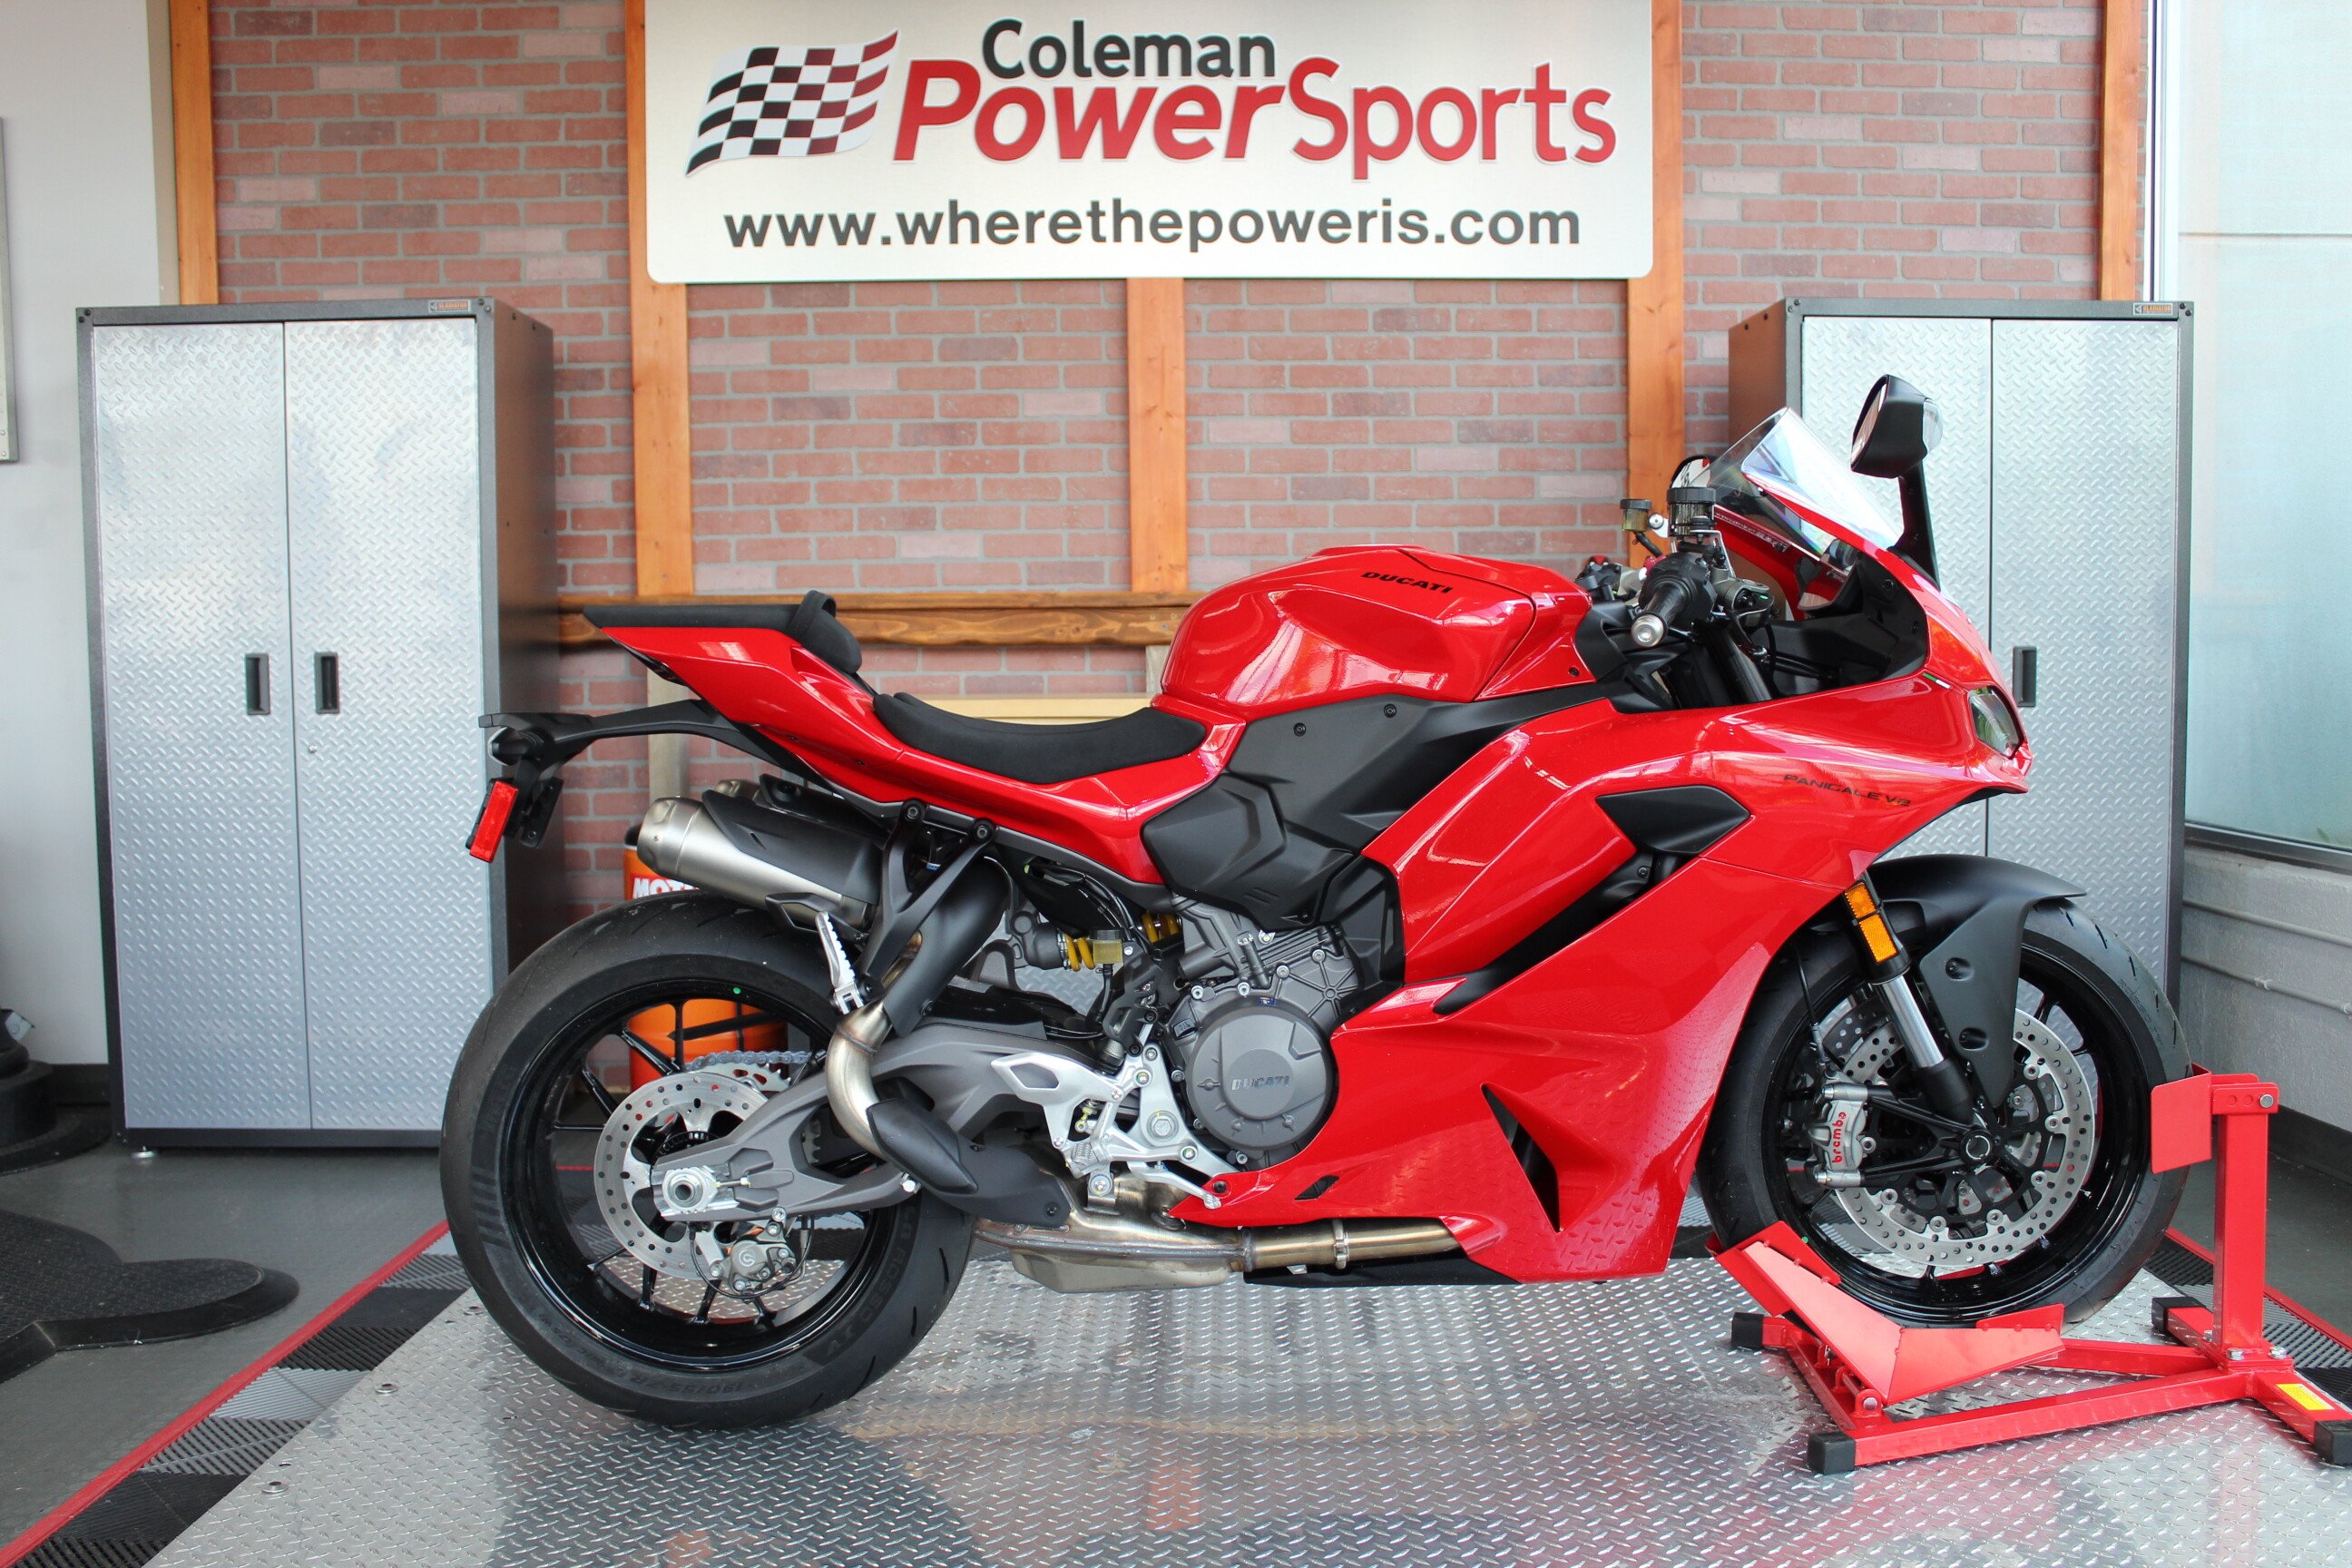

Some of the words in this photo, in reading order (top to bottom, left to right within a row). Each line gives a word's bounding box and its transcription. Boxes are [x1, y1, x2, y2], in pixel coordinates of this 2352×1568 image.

[982, 18, 1276, 80] Coleman
[893, 57, 1617, 181] PowerSports
[724, 199, 1580, 253] www.wherethepoweris.com
[1360, 572, 1454, 593] DUCATI
[632, 877, 700, 899] MOT
[1231, 1076, 1289, 1091] DUCATI
[1831, 1112, 1847, 1164] brembo
